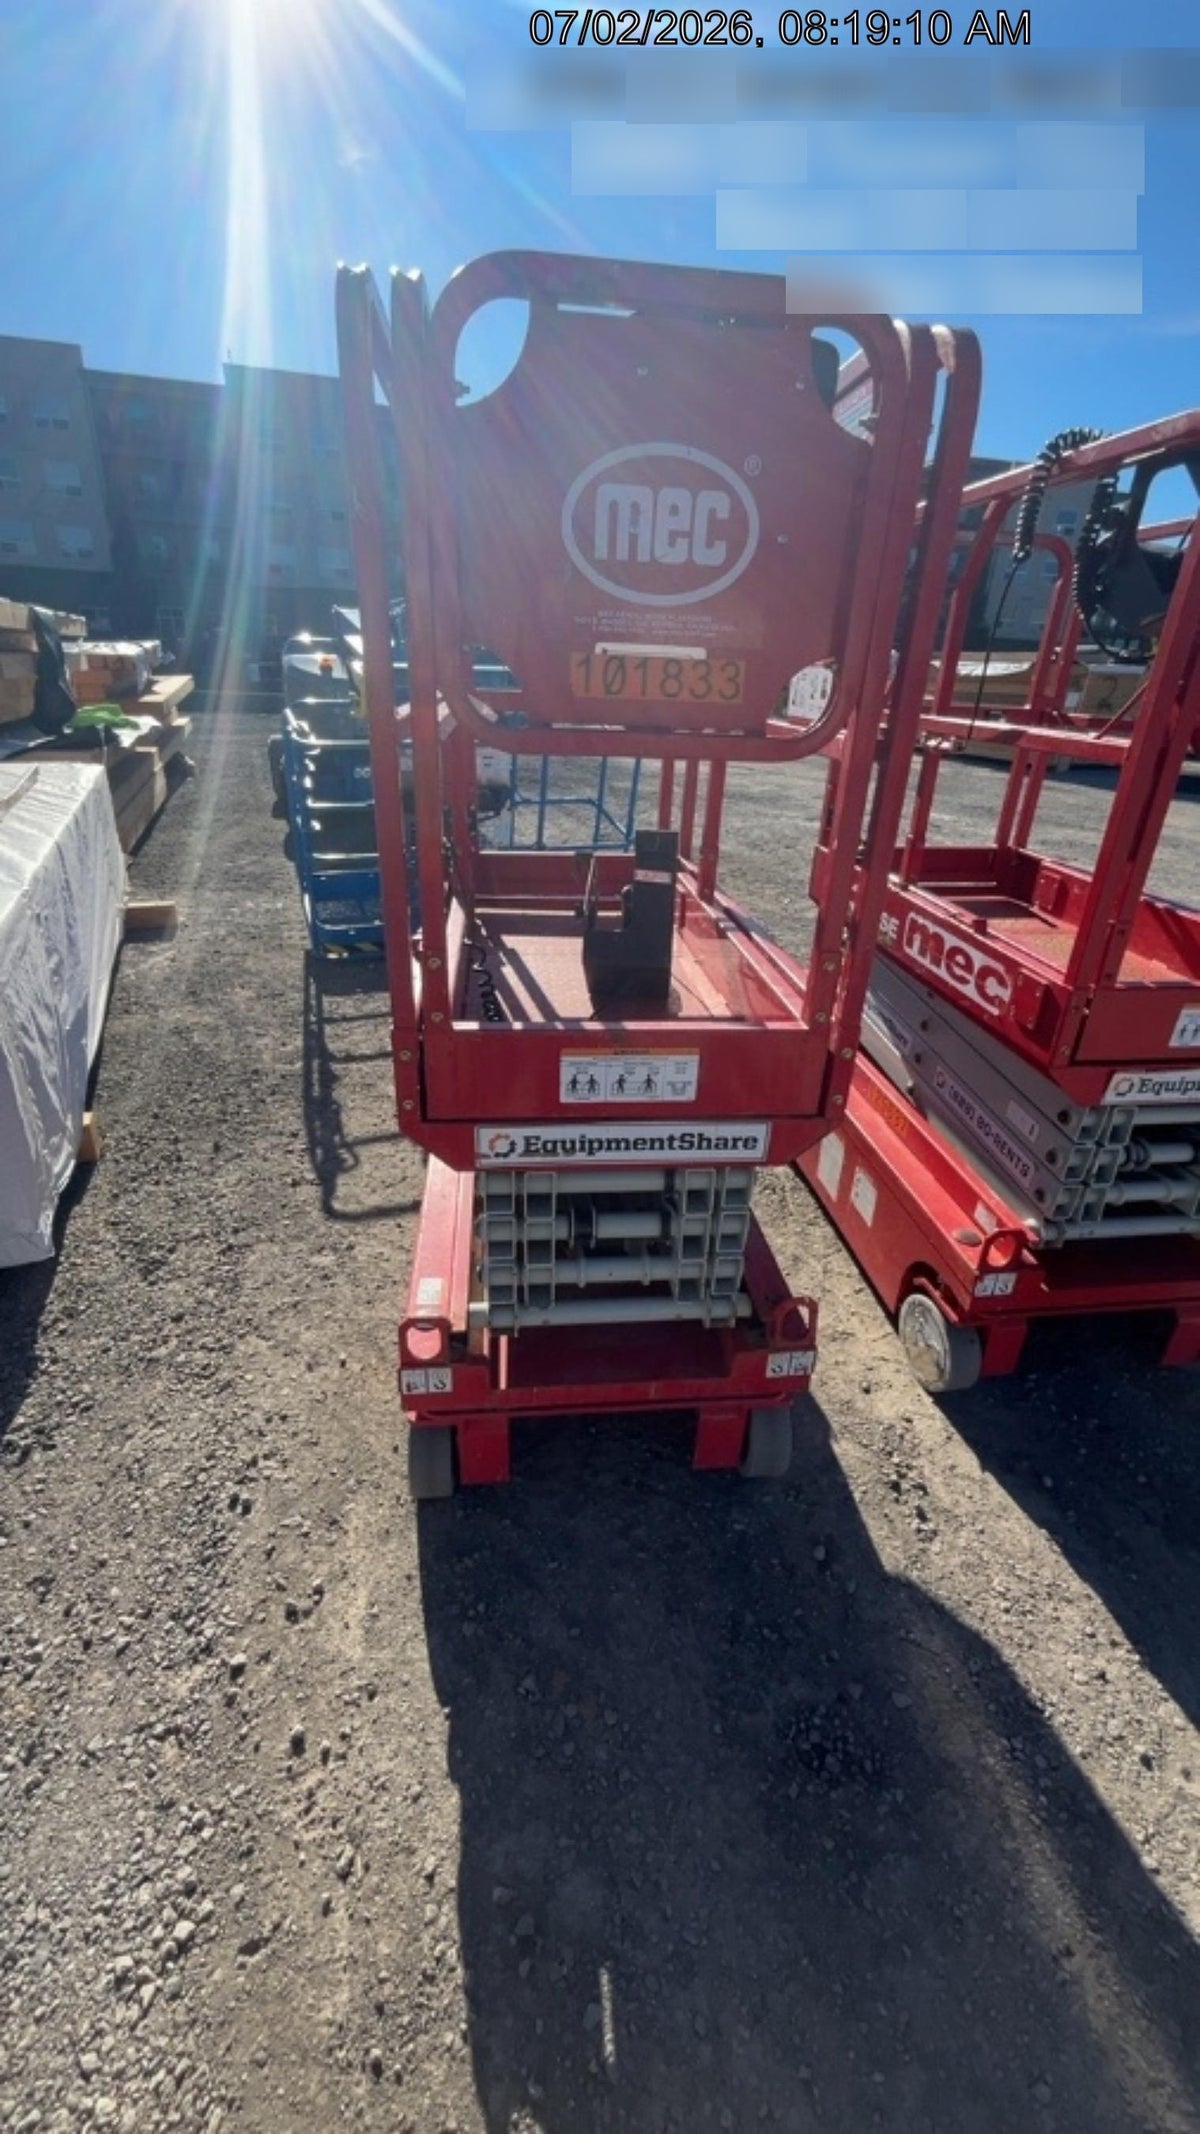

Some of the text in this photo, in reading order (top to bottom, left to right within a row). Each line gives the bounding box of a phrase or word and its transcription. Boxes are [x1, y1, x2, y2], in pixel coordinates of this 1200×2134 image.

[575, 654, 741, 701] 101833
[1137, 1076, 1200, 1096] Equip
[522, 1131, 759, 1158] EquipmentShare
